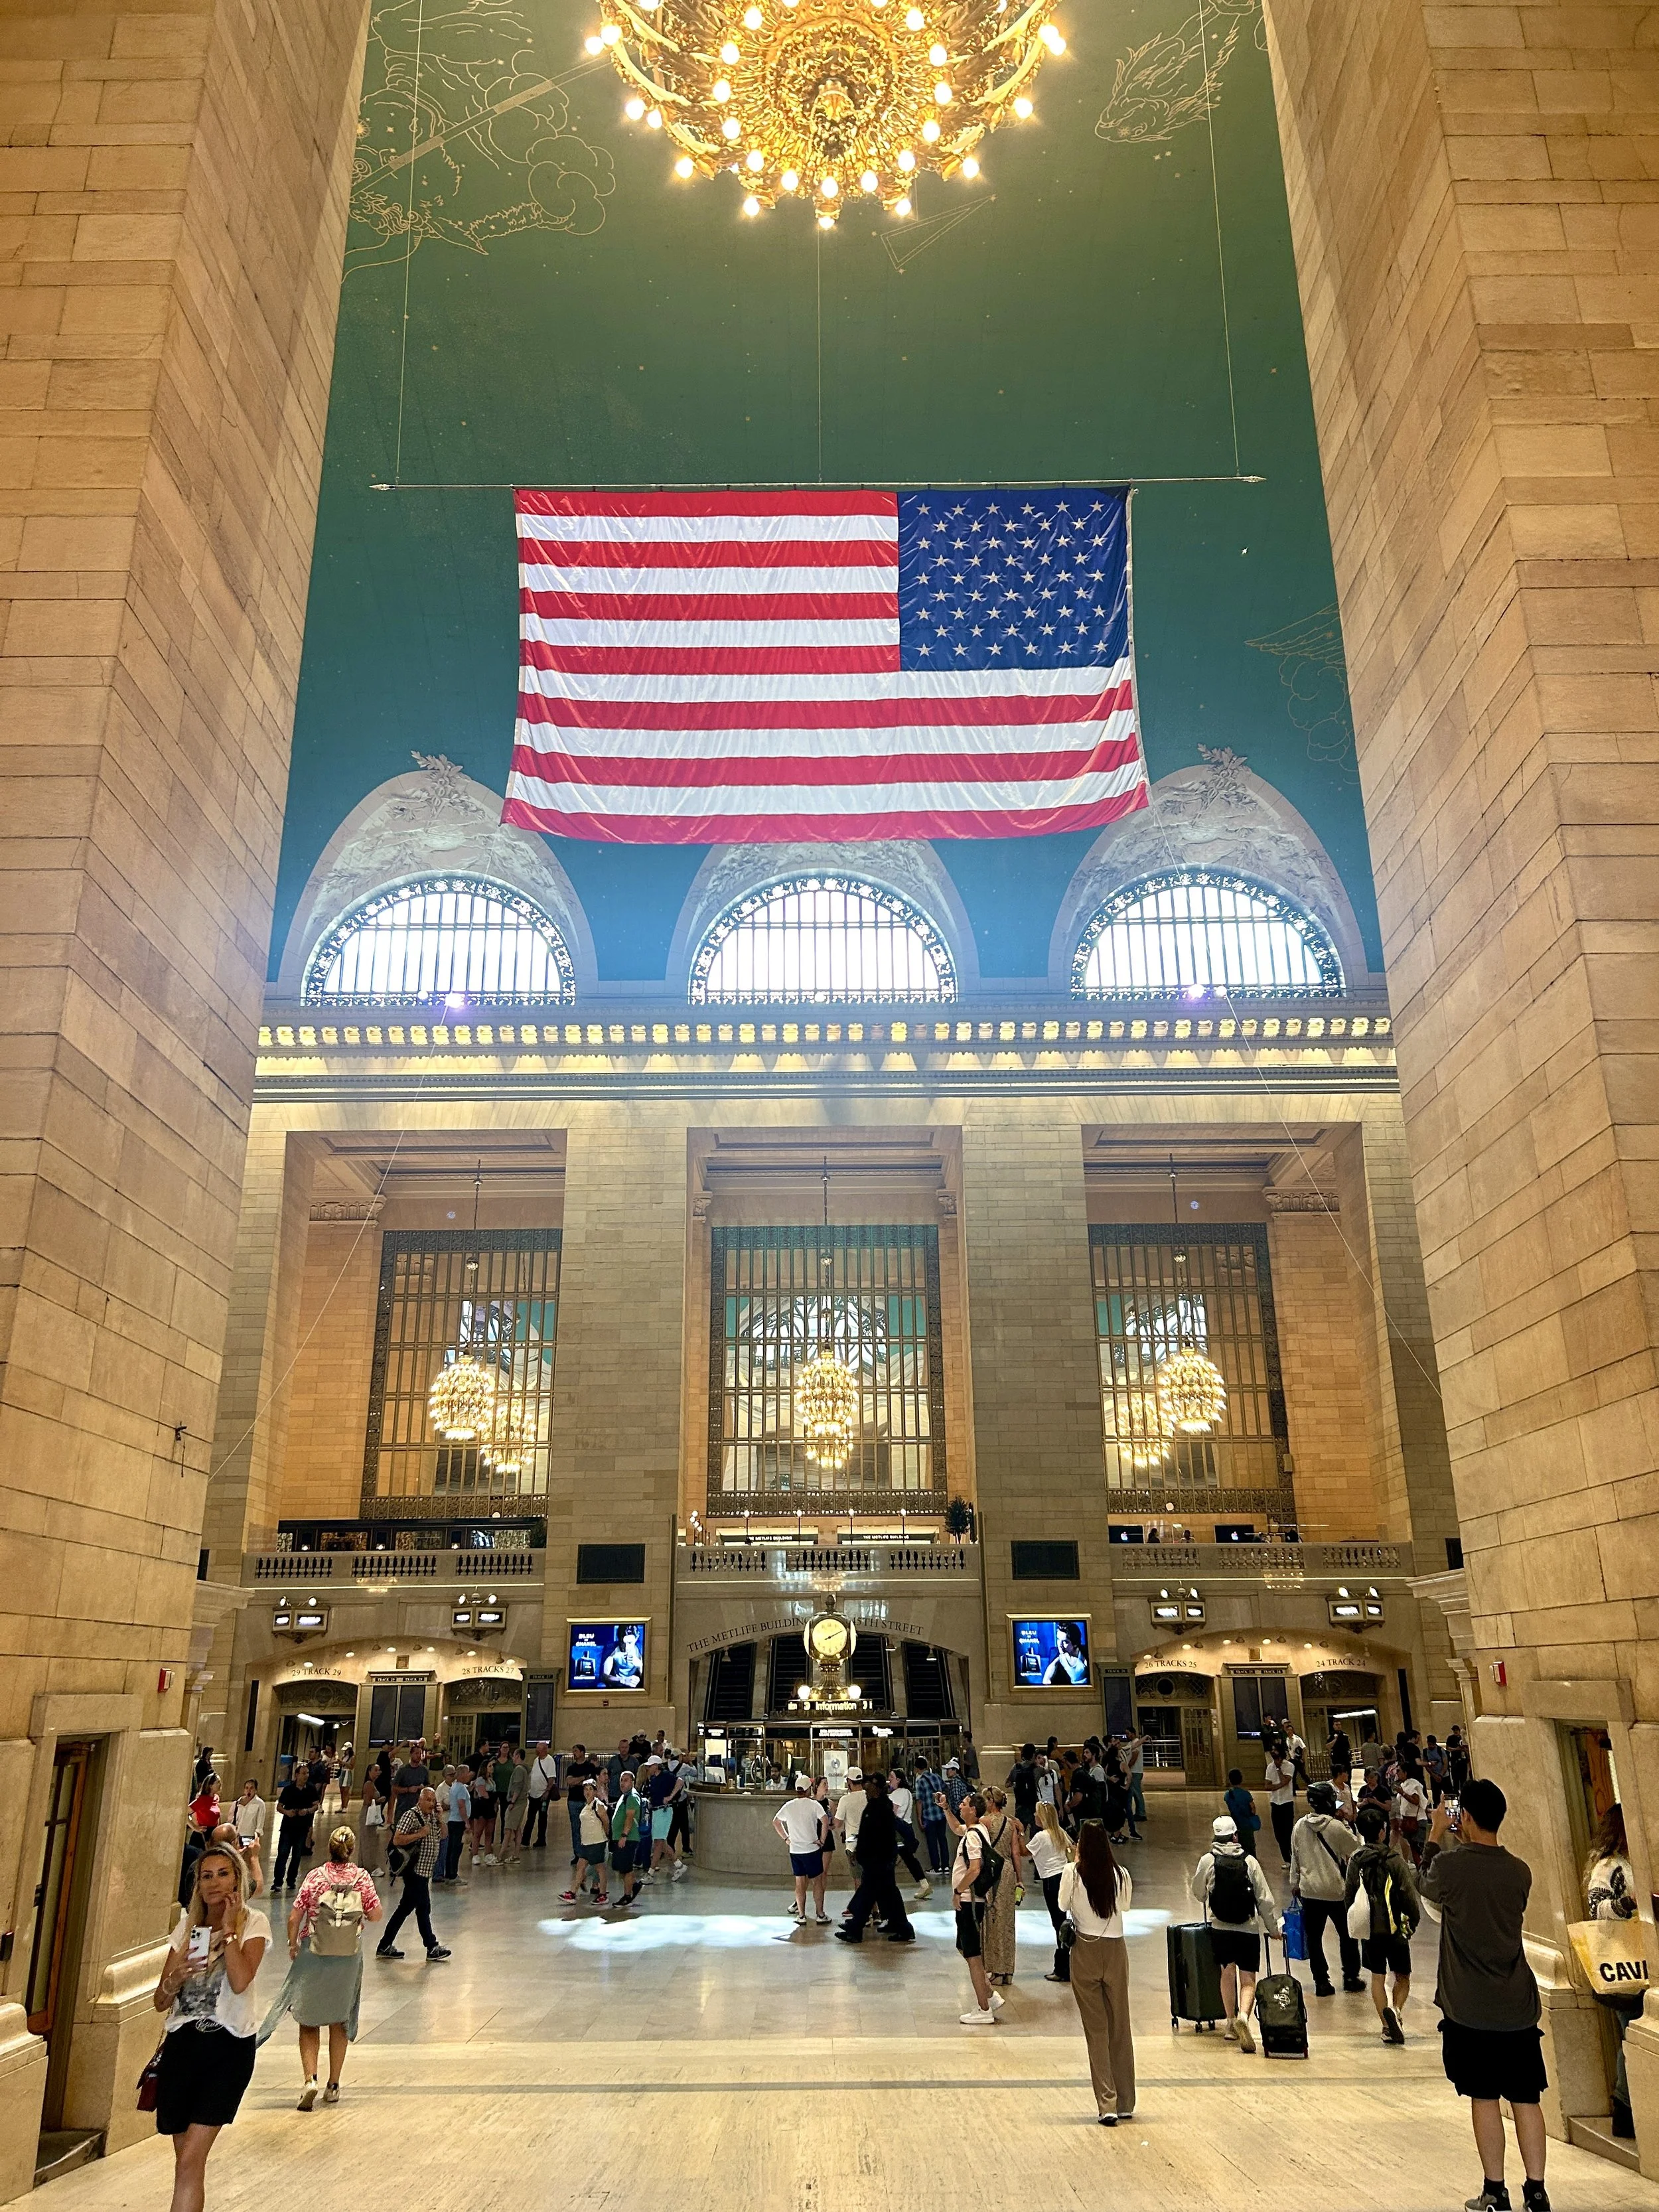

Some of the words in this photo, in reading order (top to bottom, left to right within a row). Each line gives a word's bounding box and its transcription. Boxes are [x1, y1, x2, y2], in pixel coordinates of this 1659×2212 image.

[686, 1637, 710, 1652] THE
[711, 1623, 758, 1643] METLIFE
[881, 1619, 924, 1635] STREET
[816, 1701, 857, 1710] Information
[1599, 1960, 1649, 1982] CAVI
